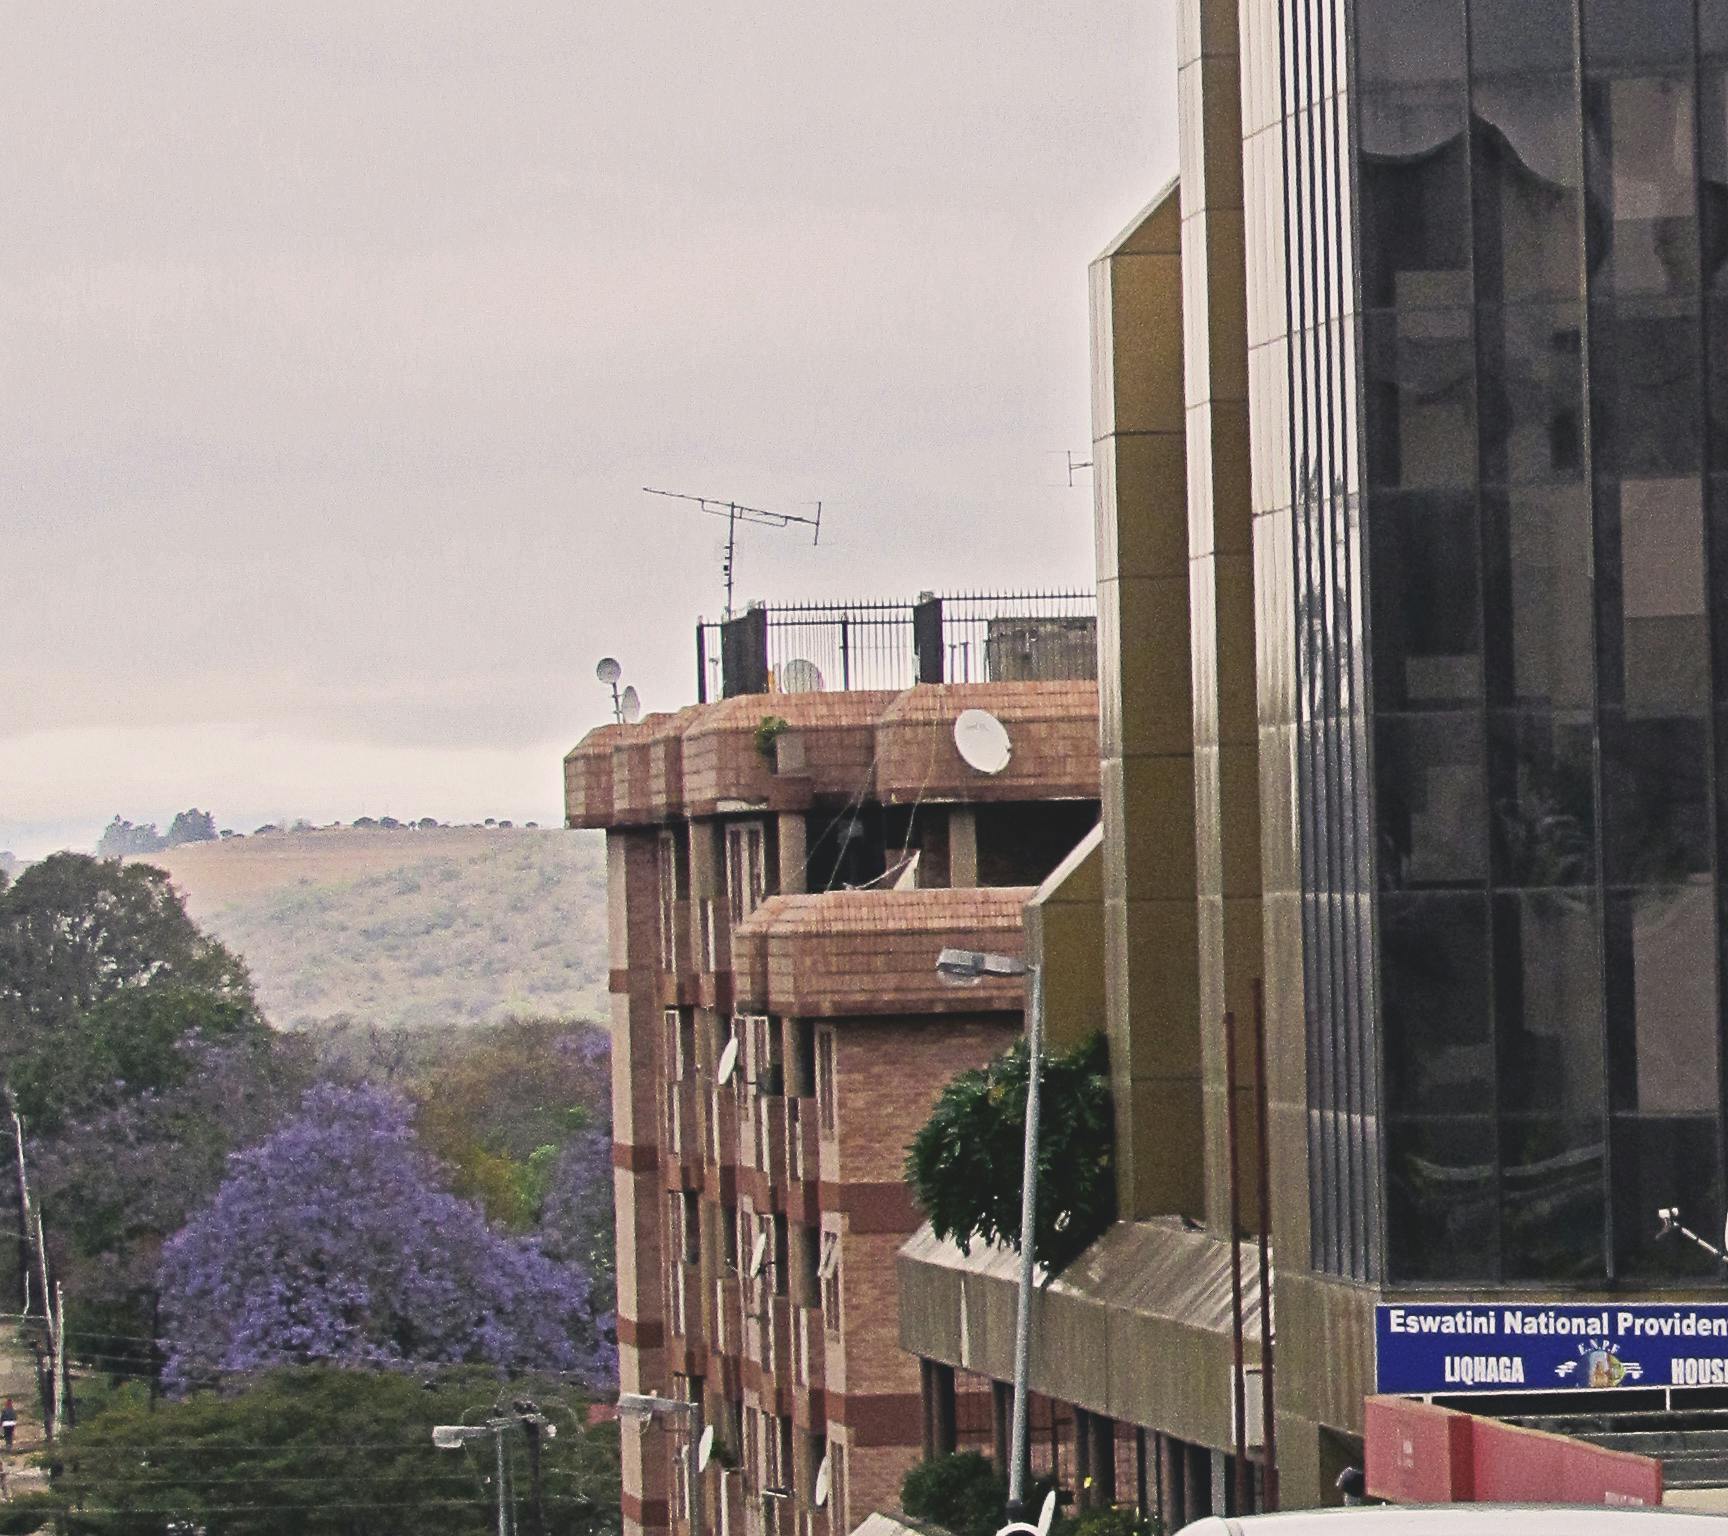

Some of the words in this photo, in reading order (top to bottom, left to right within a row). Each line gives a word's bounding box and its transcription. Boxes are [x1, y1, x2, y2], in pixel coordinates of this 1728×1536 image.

[1390, 1309, 1497, 1334] Eswatini
[1504, 1310, 1609, 1335] National
[1444, 1356, 1525, 1385] LIQHAGA
